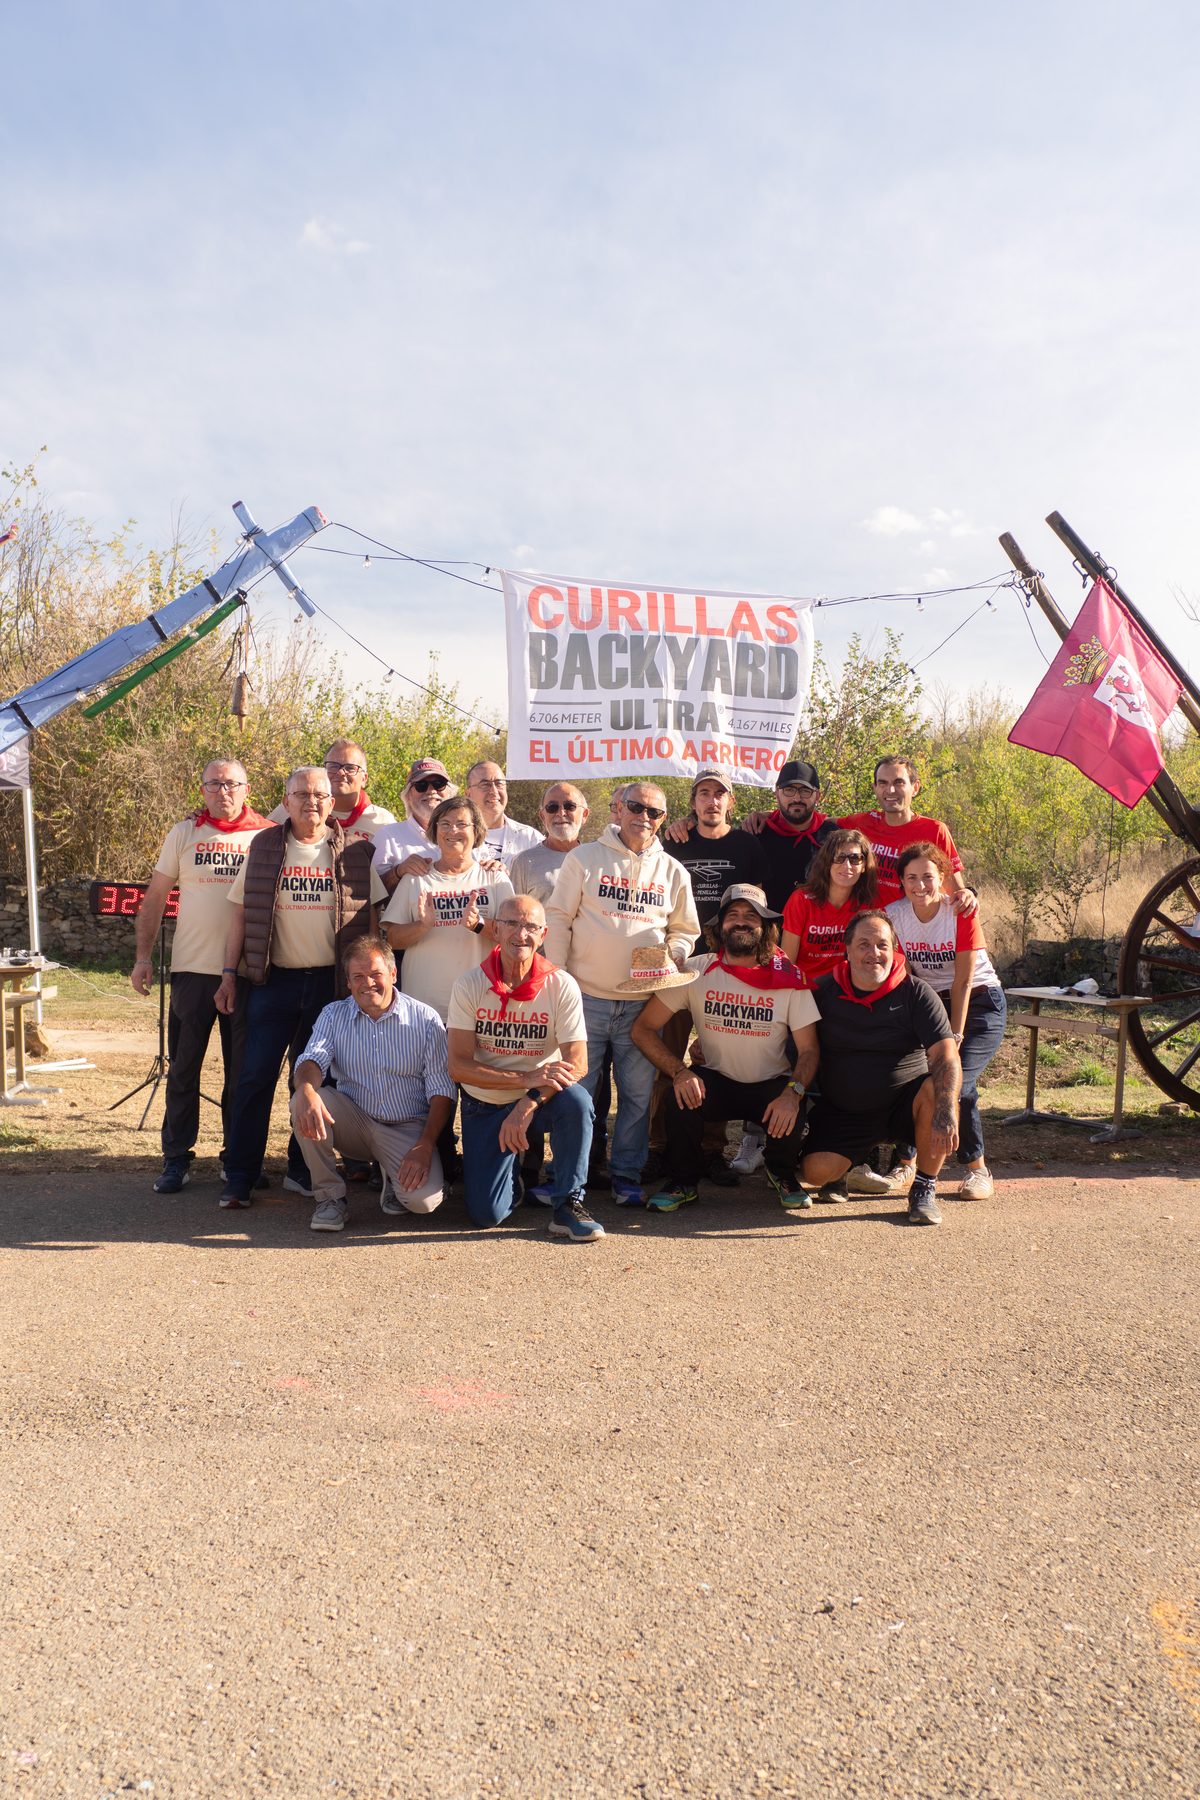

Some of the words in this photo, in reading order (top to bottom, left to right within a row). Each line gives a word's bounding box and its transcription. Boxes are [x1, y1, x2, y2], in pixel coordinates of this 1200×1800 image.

[527, 584, 798, 645] CURILLAS
[528, 631, 798, 701] BACKYARD
[529, 712, 558, 724] 6.706
[560, 712, 602, 724] METER
[727, 717, 757, 731] 4.167
[759, 720, 793, 735] MILES
[529, 739, 560, 764] EL
[567, 734, 674, 764] ÚLTIMO
[681, 739, 788, 773] ARRIERO
[196, 842, 250, 855] CURILL
[195, 852, 245, 867] BACKYA
[283, 866, 333, 878] URILLA
[281, 877, 334, 892] ACKYAR
[292, 893, 321, 902] ULTRA
[440, 910, 463, 920] ULTR
[809, 925, 845, 935] CURILL
[905, 941, 954, 952] CURILLAS
[906, 950, 956, 962] BACKYARD
[706, 990, 774, 1008] CURILLAS
[704, 1000, 774, 1022] BACKYARD
[475, 1020, 548, 1039] BACKYARD
[723, 1019, 752, 1029] ULTRA
[740, 1029, 771, 1037] ARRIERO
[495, 1038, 524, 1049] ULTRA
[512, 1049, 544, 1057] ARRIERO
